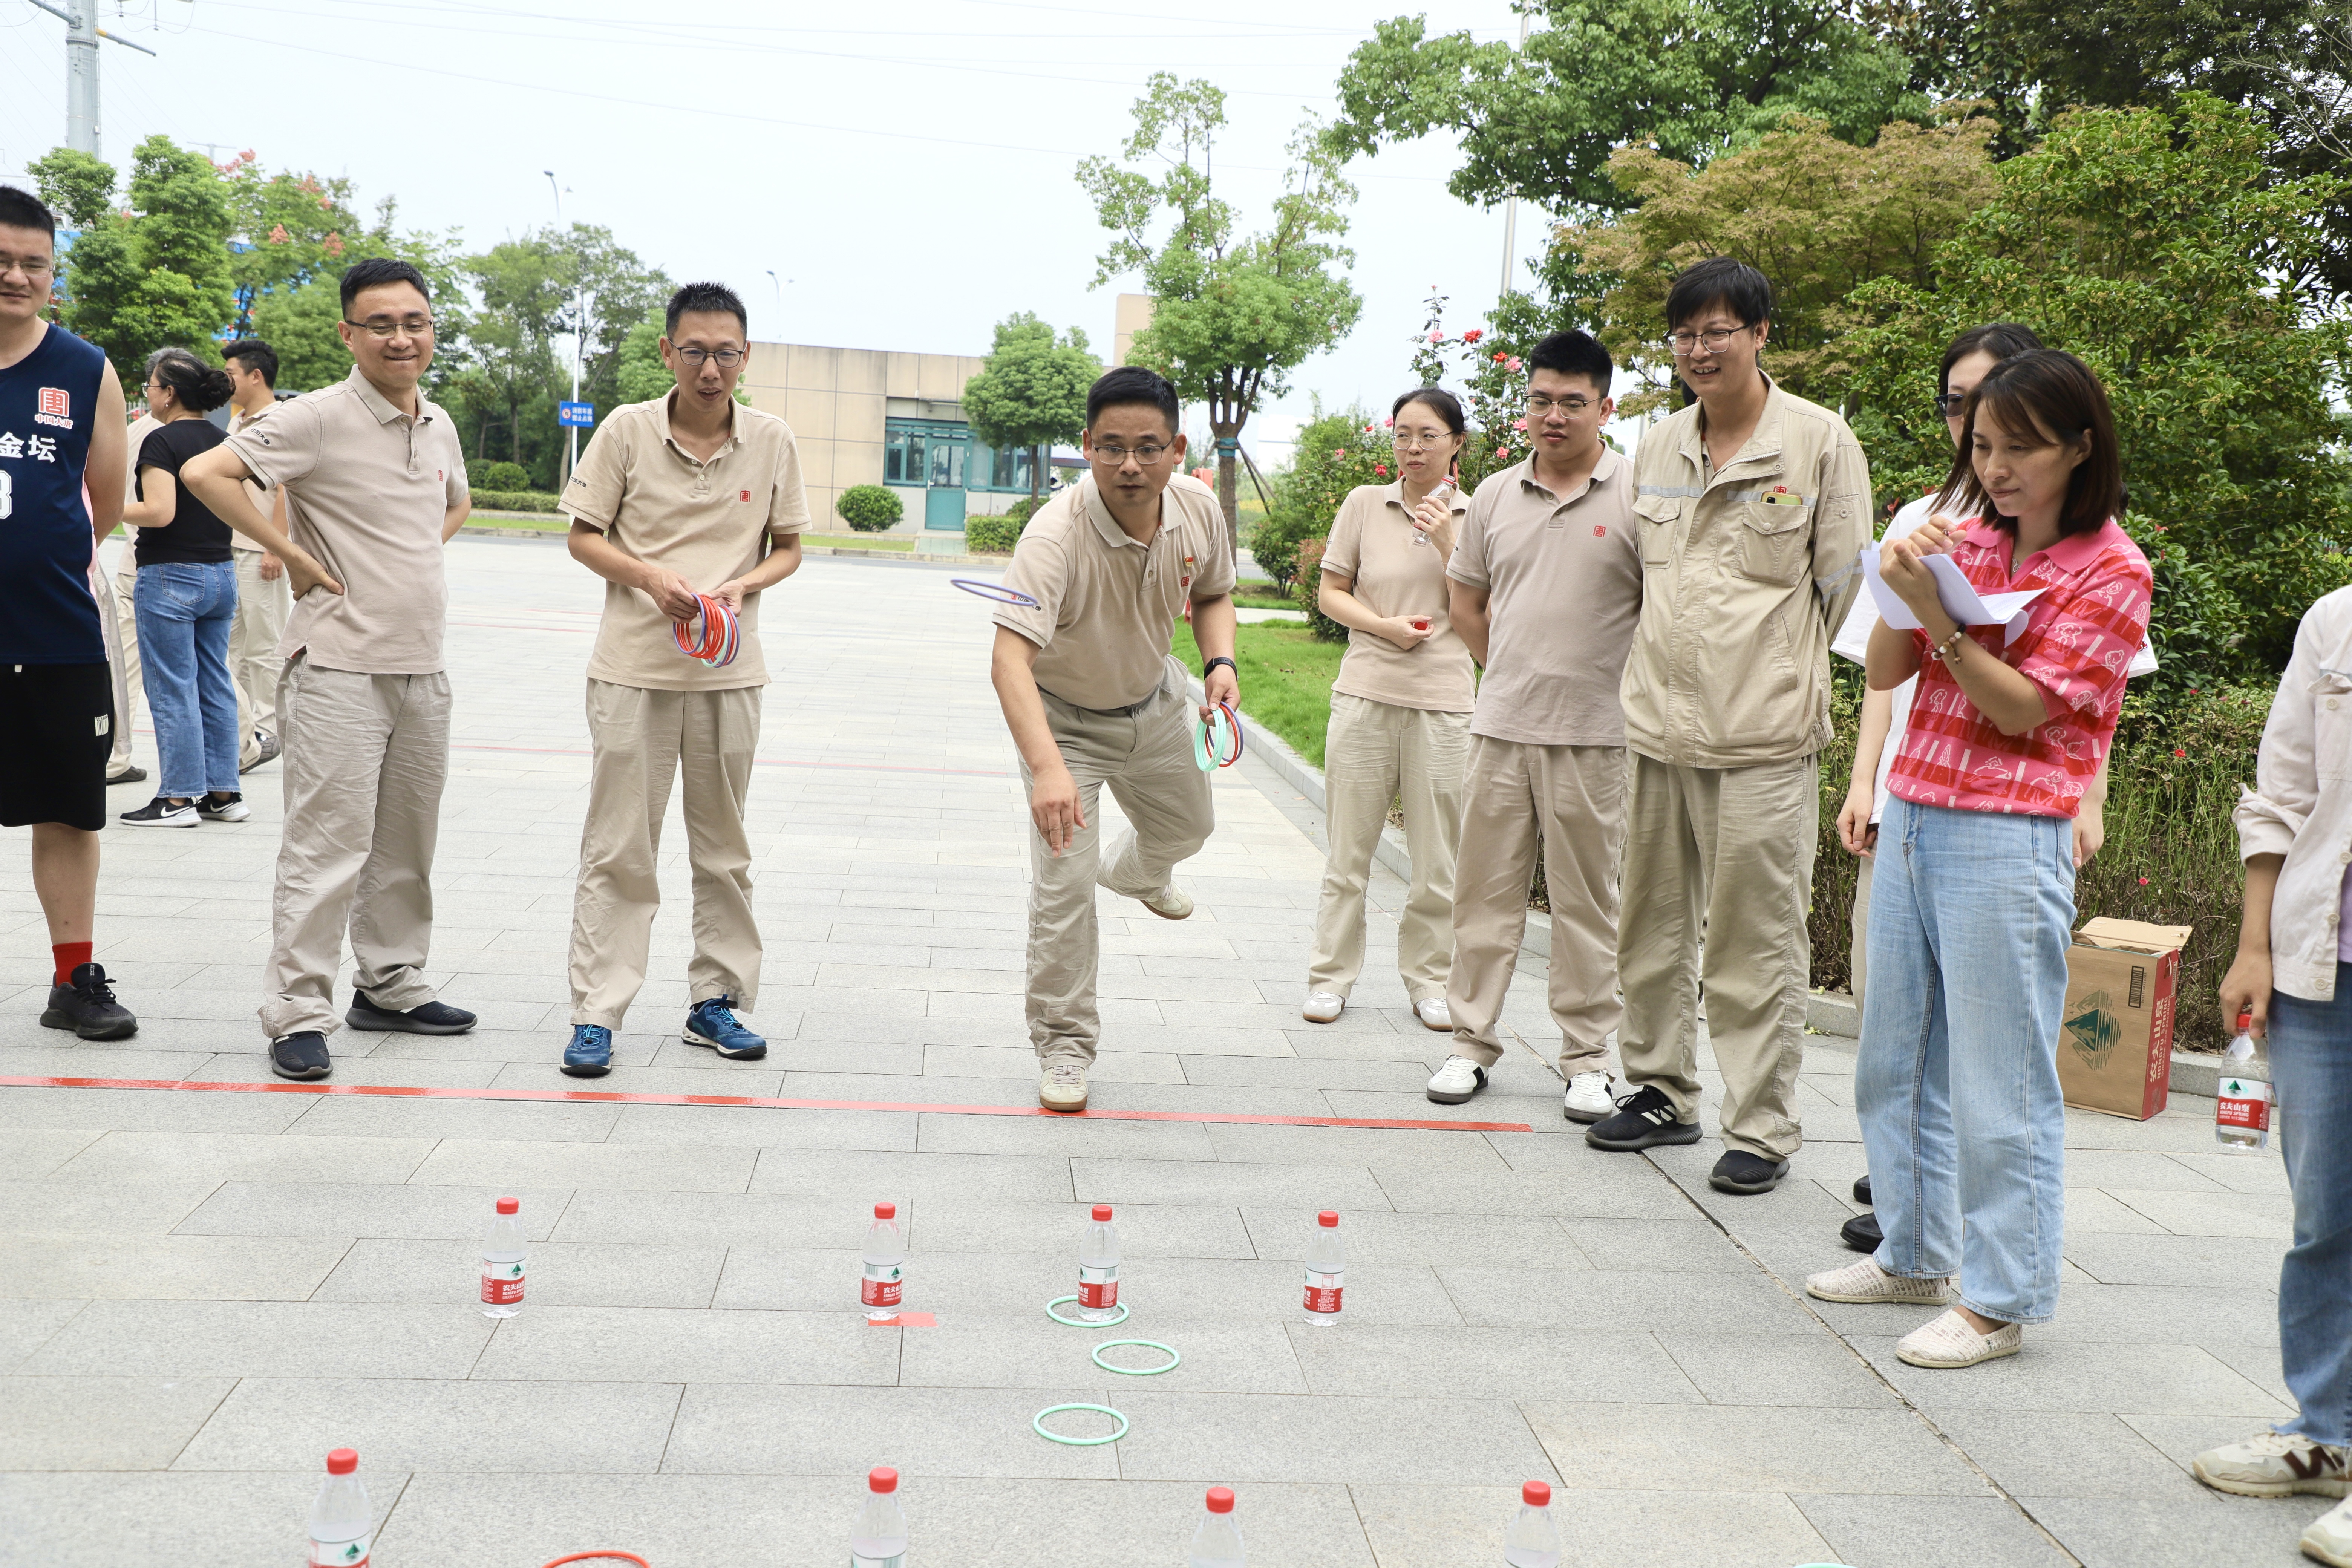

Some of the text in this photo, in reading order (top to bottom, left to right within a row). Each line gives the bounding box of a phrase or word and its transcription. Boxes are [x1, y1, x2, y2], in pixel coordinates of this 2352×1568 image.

[39, 387, 69, 417] 唐
[35, 414, 74, 429] 中国大唐
[251, 428, 270, 445] 中国大唐
[0, 431, 57, 463] 金坛
[570, 477, 586, 488] 中国大唐
[740, 490, 750, 502] 唐
[1593, 525, 1606, 538] 唐
[2150, 998, 2164, 1082] 农夫山泉
[2220, 1102, 2250, 1112] 农夫山泉
